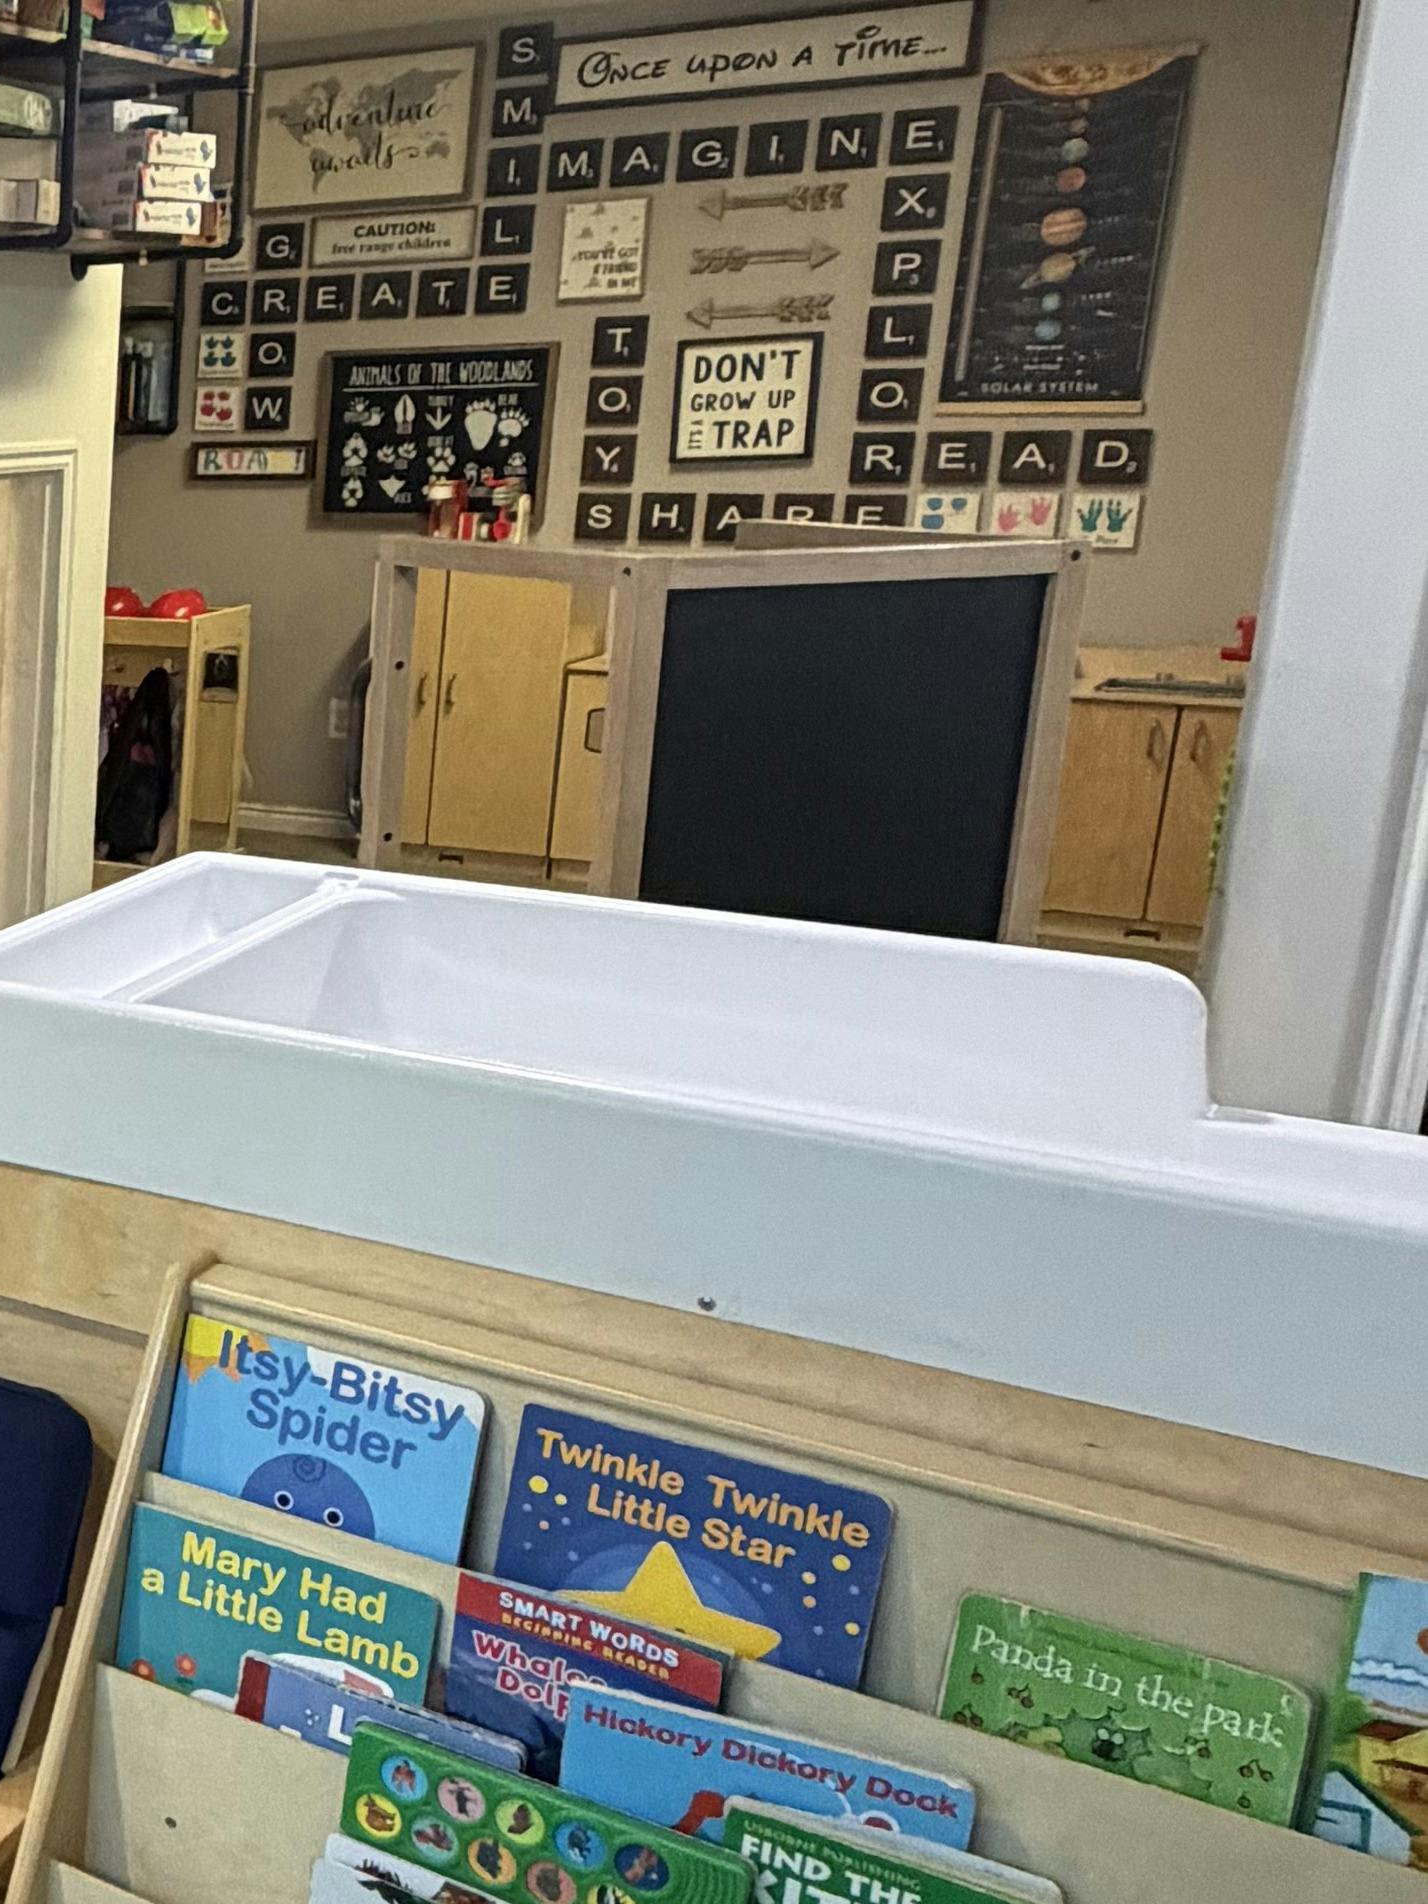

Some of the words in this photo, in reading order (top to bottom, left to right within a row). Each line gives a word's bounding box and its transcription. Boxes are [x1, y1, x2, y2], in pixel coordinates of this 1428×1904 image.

[294, 87, 448, 135] adventure
[311, 132, 420, 174] awaits
[354, 222, 436, 239] CAUTION:
[359, 241, 394, 256] range
[398, 237, 451, 253] children
[349, 363, 402, 386] ANIMALS
[407, 362, 423, 384] OF
[430, 361, 452, 384] THE
[459, 358, 534, 383] WOODLANDS
[693, 350, 802, 384] DON'T
[980, 381, 1033, 394] SOLAR
[1038, 379, 1100, 394] SYSTEM
[690, 390, 757, 413] GROW
[768, 389, 796, 409] UP
[712, 418, 795, 450] TRAP
[218, 1329, 465, 1441] Itsy-Bitsy
[246, 1388, 417, 1469] Spider
[537, 1427, 685, 1496] Twinkle
[707, 1475, 870, 1549] Twinkle
[587, 1483, 690, 1540] Little
[700, 1516, 796, 1569] Star
[182, 1530, 287, 1596] Mary
[300, 1567, 388, 1625] Had
[141, 1567, 164, 1595] a
[178, 1570, 283, 1633] Little
[296, 1610, 419, 1679] Lamb
[499, 1591, 585, 1632] SMART
[589, 1619, 680, 1668] WORDS
[601, 1645, 670, 1680] READER
[971, 1624, 1075, 1684] Panda
[1082, 1660, 1123, 1698] in
[1135, 1674, 1195, 1718] the
[1201, 1702, 1286, 1750] park
[584, 1703, 713, 1758] Hickory
[721, 1737, 858, 1794] Dickory
[865, 1773, 960, 1820] Dock
[741, 1833, 832, 1882] FIND
